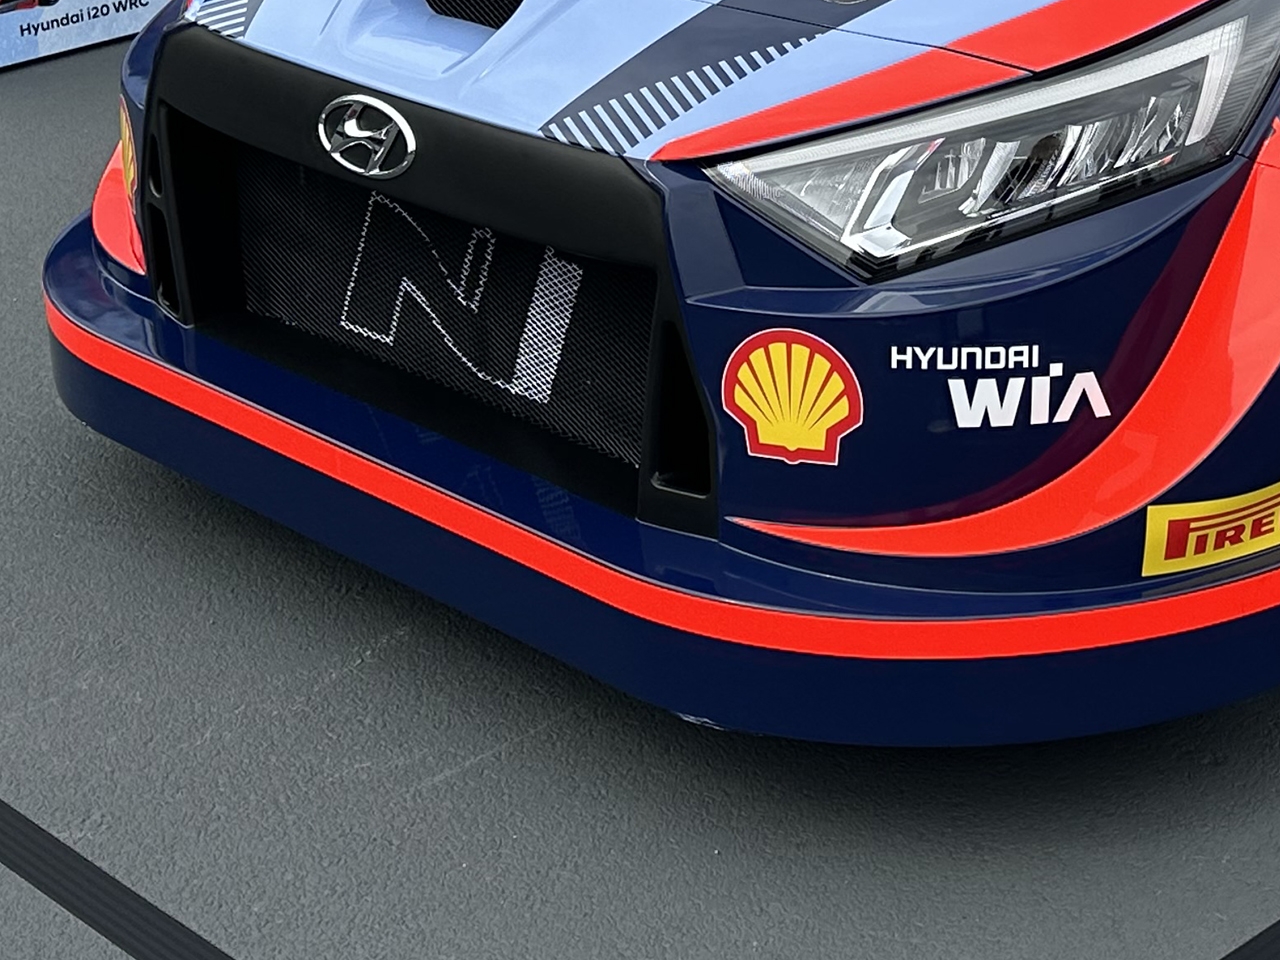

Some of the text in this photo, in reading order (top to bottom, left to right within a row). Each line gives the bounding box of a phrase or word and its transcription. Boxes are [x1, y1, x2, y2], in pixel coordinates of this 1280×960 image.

[19, 8, 84, 36] Hyundai
[86, 3, 110, 21] i20
[890, 344, 1040, 371] HYUNDAI
[947, 362, 1112, 429] WIA
